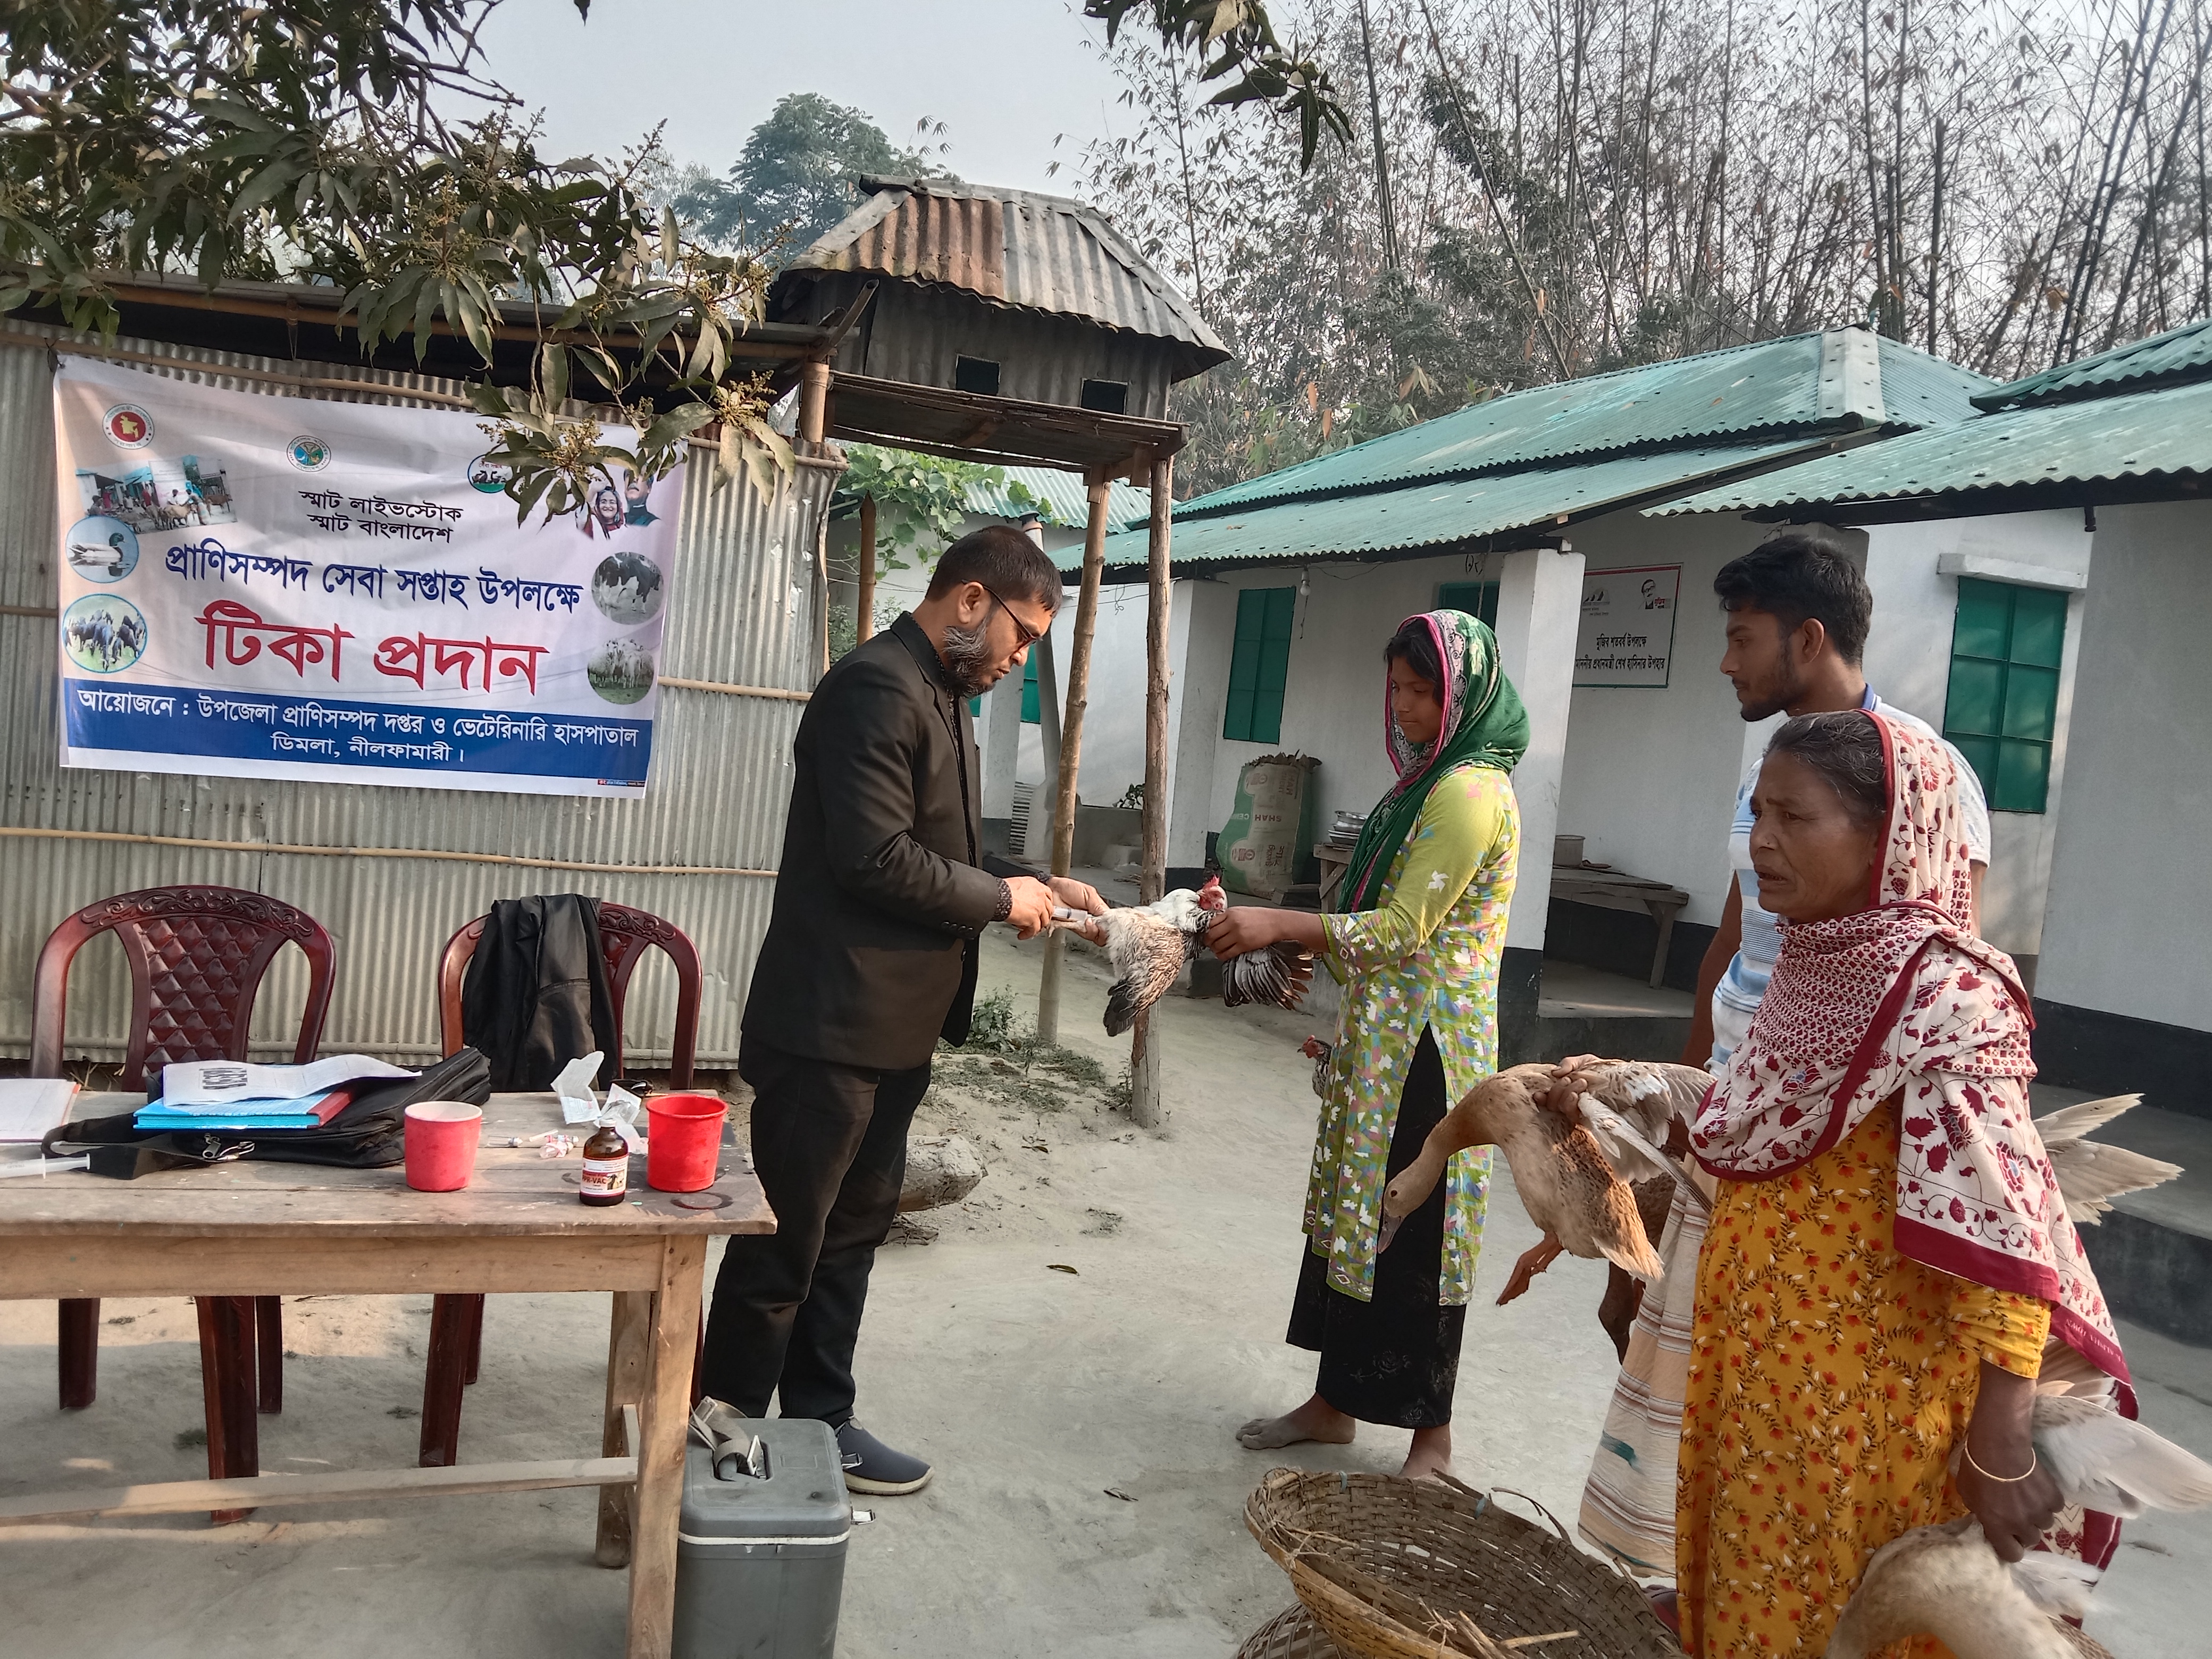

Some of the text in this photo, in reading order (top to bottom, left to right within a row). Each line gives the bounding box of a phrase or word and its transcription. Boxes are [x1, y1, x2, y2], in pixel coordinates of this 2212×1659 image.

[348, 495, 464, 522] লাইভস্টোক
[357, 519, 454, 543] বাংলাদেশ
[166, 538, 584, 614] প্রাণিসম্পদ সেবা সপ্তাহ উপলক্ষে
[195, 600, 549, 696] টিকা প্রদান
[1615, 657, 1626, 669] শেখ
[77, 688, 177, 718] আয়োজনে
[196, 692, 279, 725] উপজেলা
[282, 701, 379, 732] প্রাণিসম্পদ
[382, 713, 426, 734] দপ্তর
[431, 718, 446, 734] ও
[453, 713, 549, 742] ভেটেরিনারি
[552, 723, 640, 747] হাসপাতাল
[270, 731, 341, 758] ডিমলা,
[347, 735, 454, 761] নীলফামারী
